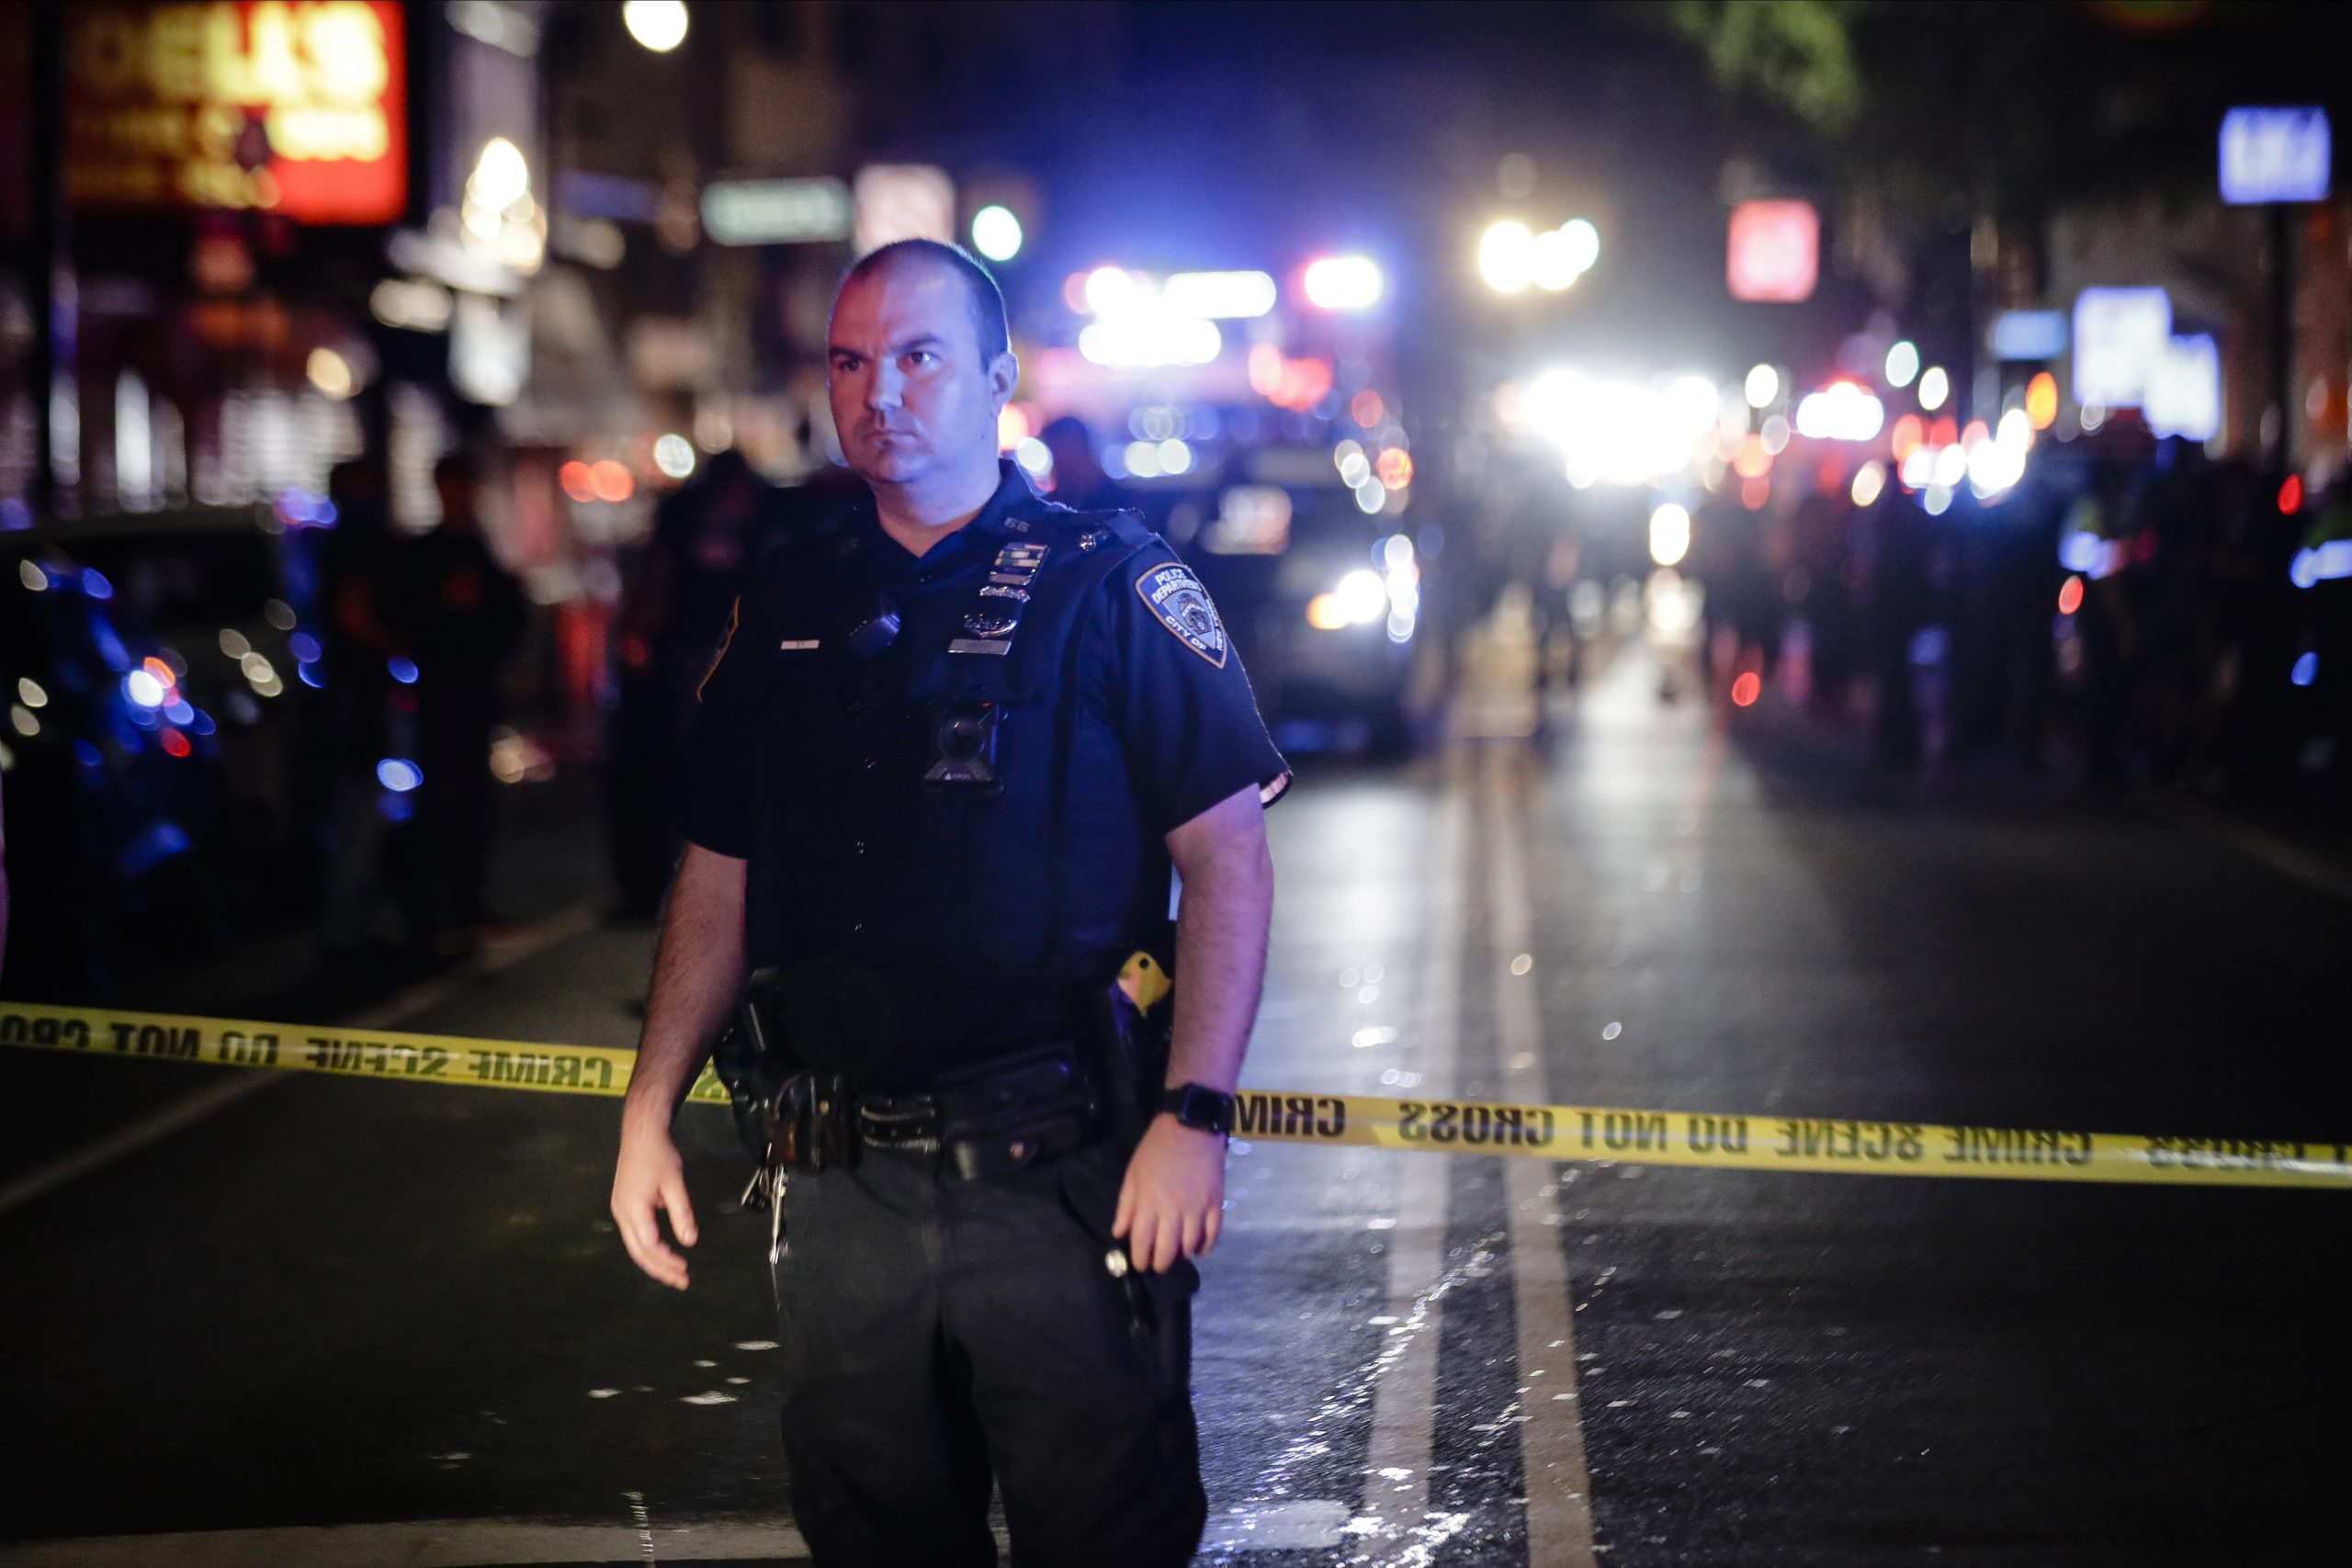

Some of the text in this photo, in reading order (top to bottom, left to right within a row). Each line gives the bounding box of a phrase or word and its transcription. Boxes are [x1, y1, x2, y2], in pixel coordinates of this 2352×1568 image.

[1155, 569, 1186, 585] POLICE
[1151, 579, 1202, 604] DEPARTMENT
[1165, 615, 1192, 637] CITY
[1191, 638, 1207, 650] OF
